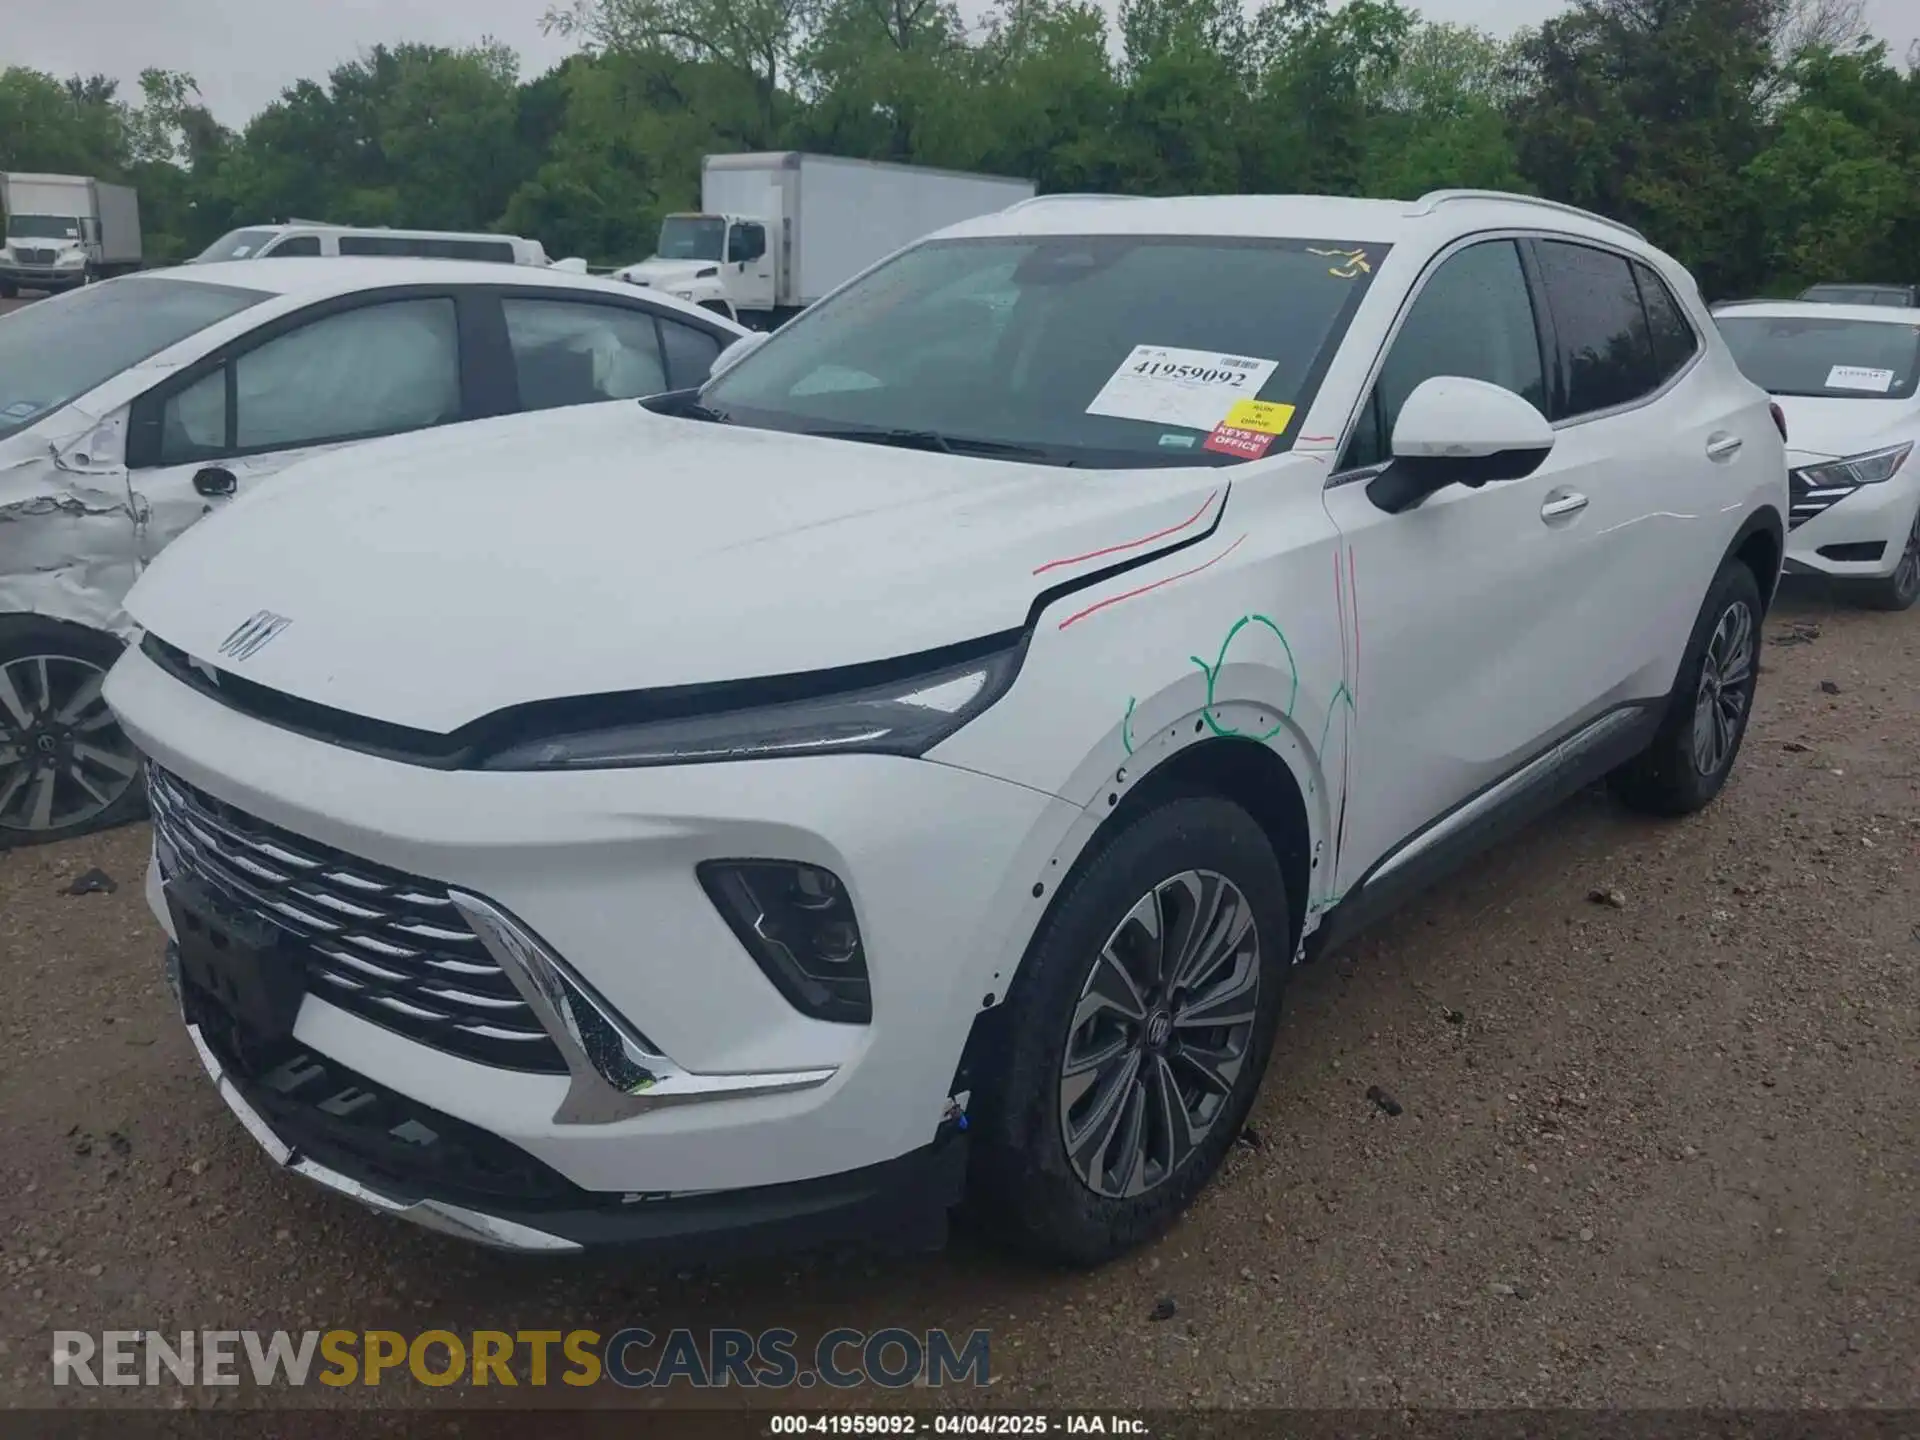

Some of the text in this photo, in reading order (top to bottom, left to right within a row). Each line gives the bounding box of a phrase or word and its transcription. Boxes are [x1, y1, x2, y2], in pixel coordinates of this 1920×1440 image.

[1133, 361, 1247, 387] 41959092
[1215, 435, 1261, 453] OFFICE
[1217, 426, 1270, 444] KEYS IN
